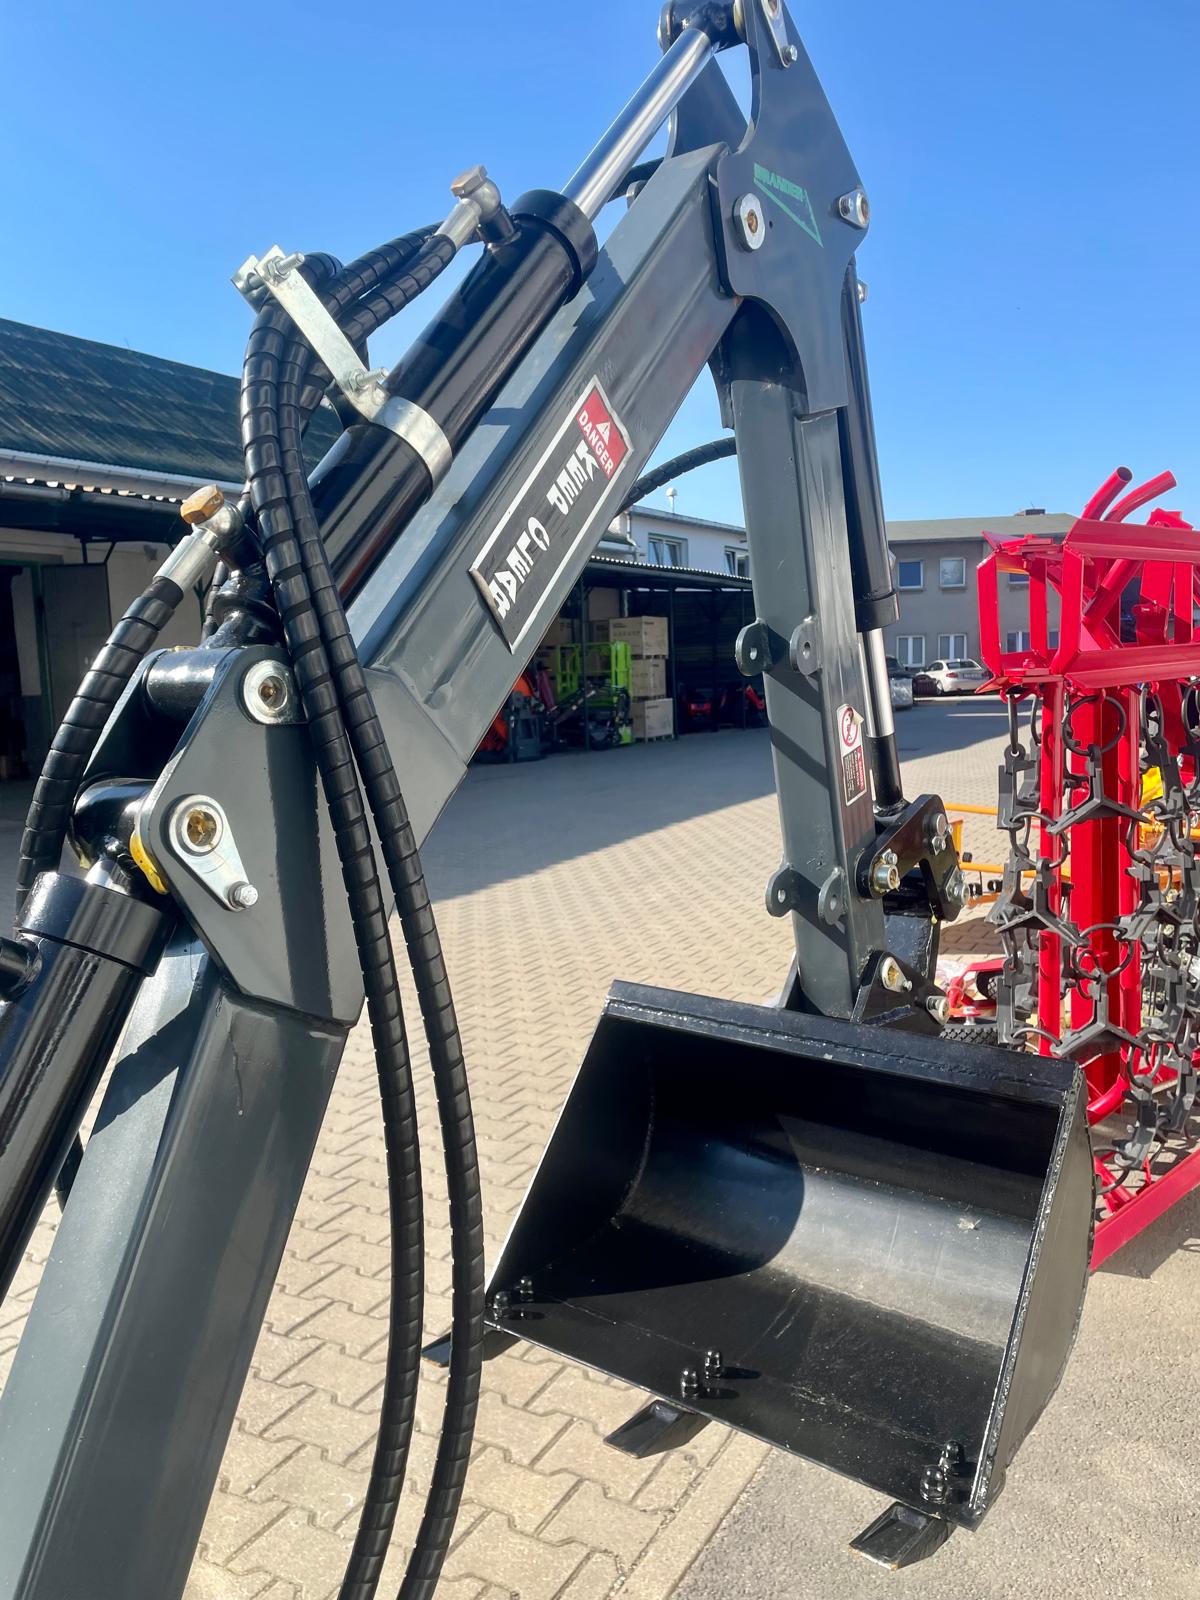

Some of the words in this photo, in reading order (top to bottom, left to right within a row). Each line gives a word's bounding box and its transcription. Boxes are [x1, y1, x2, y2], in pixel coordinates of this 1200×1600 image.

[546, 439, 599, 515] KEEP
[579, 410, 614, 475] DANGER
[488, 516, 550, 620] CLEAR
